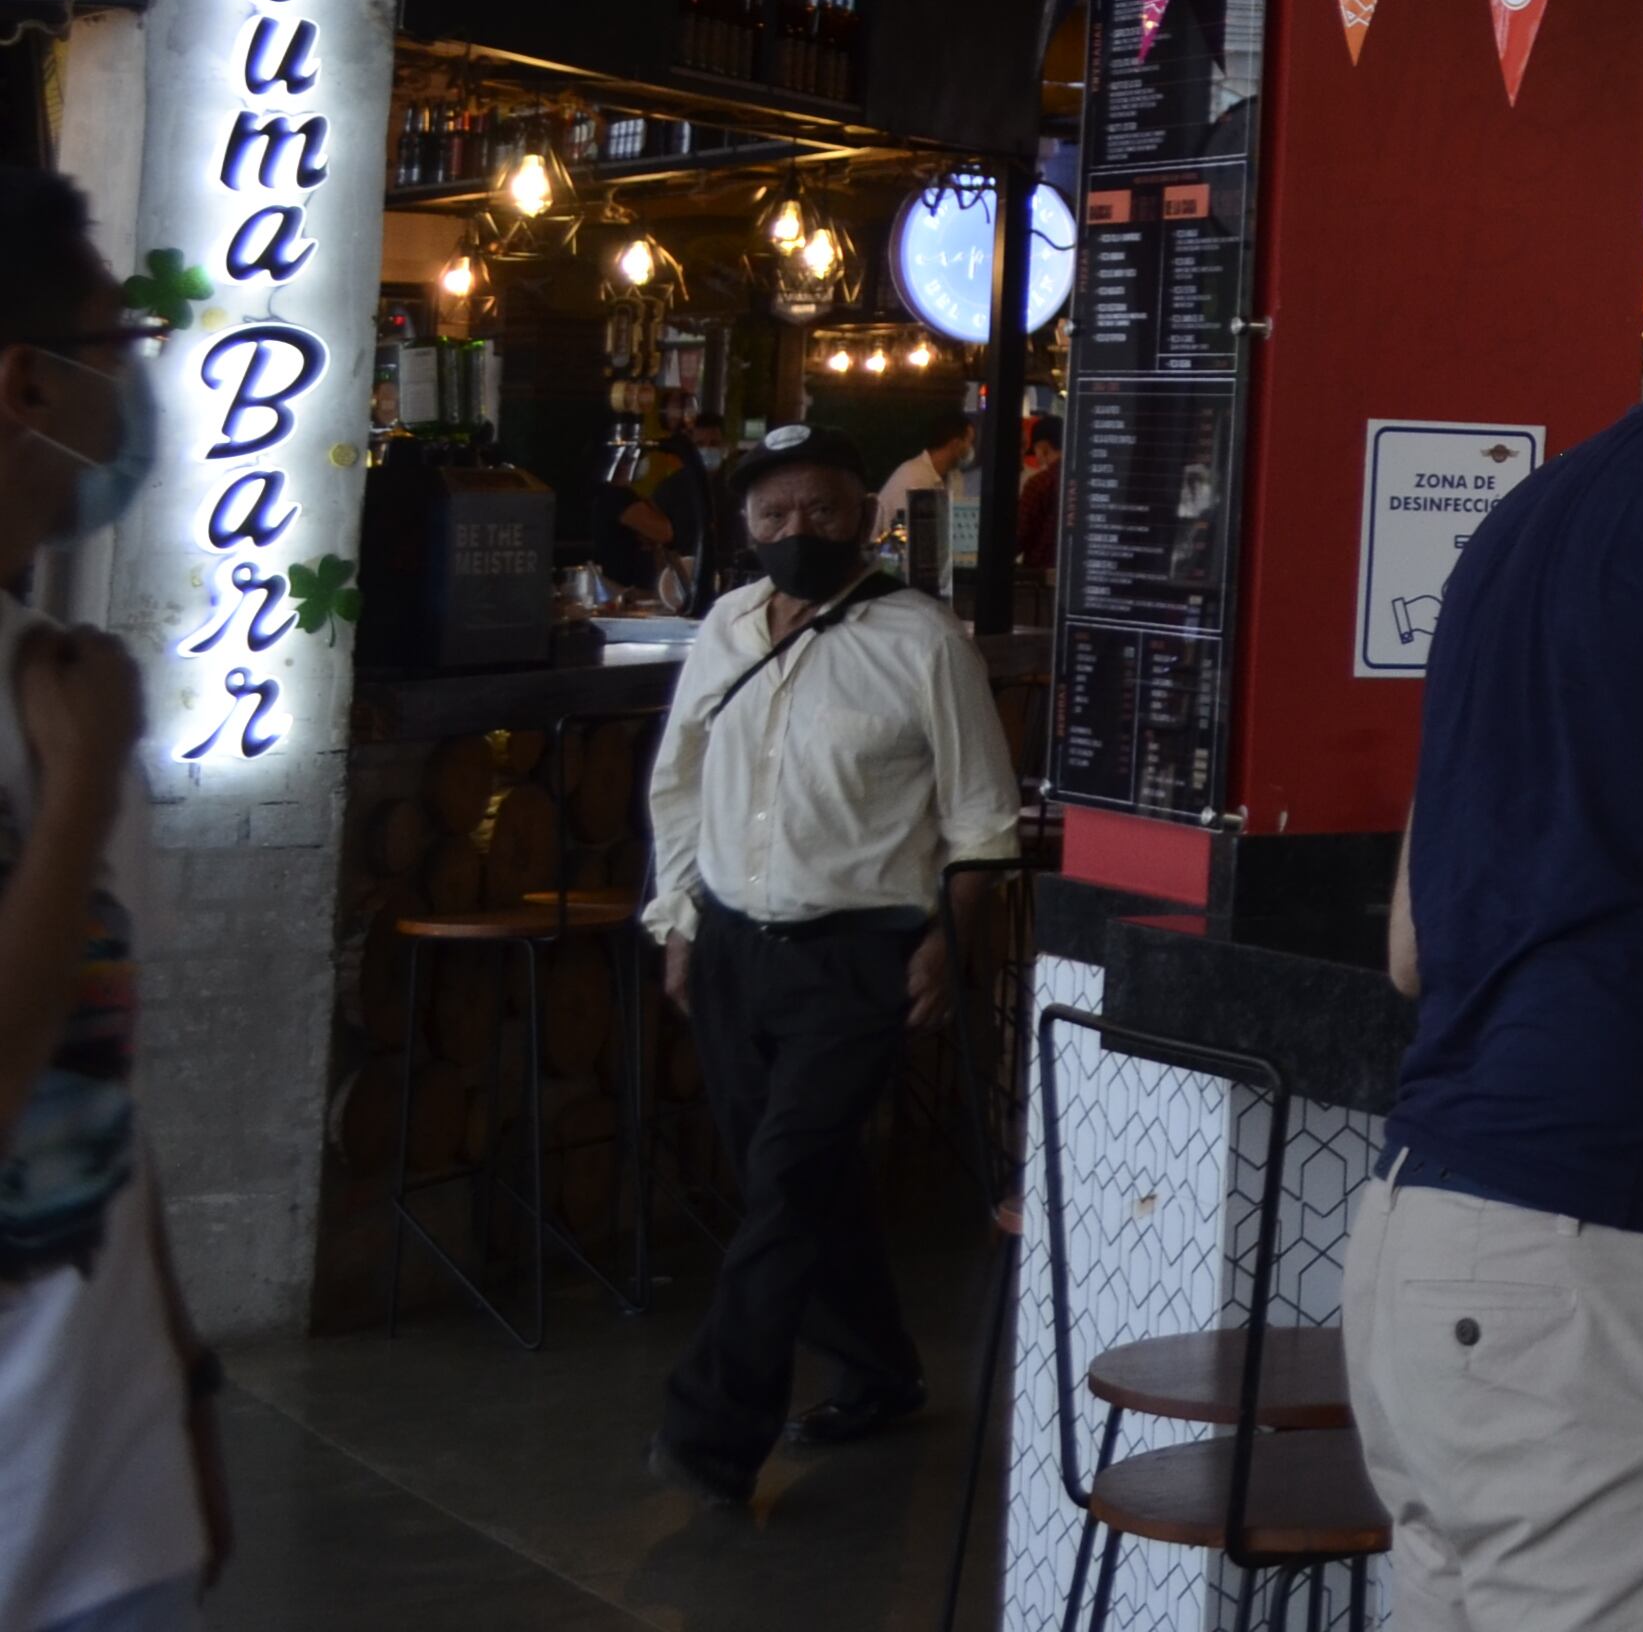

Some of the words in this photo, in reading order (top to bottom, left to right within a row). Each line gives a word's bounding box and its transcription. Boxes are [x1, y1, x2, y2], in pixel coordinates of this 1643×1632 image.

[1415, 473, 1467, 490] ZONA
[1474, 475, 1496, 490] DE
[1389, 494, 1502, 513] DESINFECCIÓ
[173, 320, 334, 764] Barr
[456, 523, 481, 547] BE
[487, 523, 524, 547] THE
[455, 551, 539, 576] MEISTER
